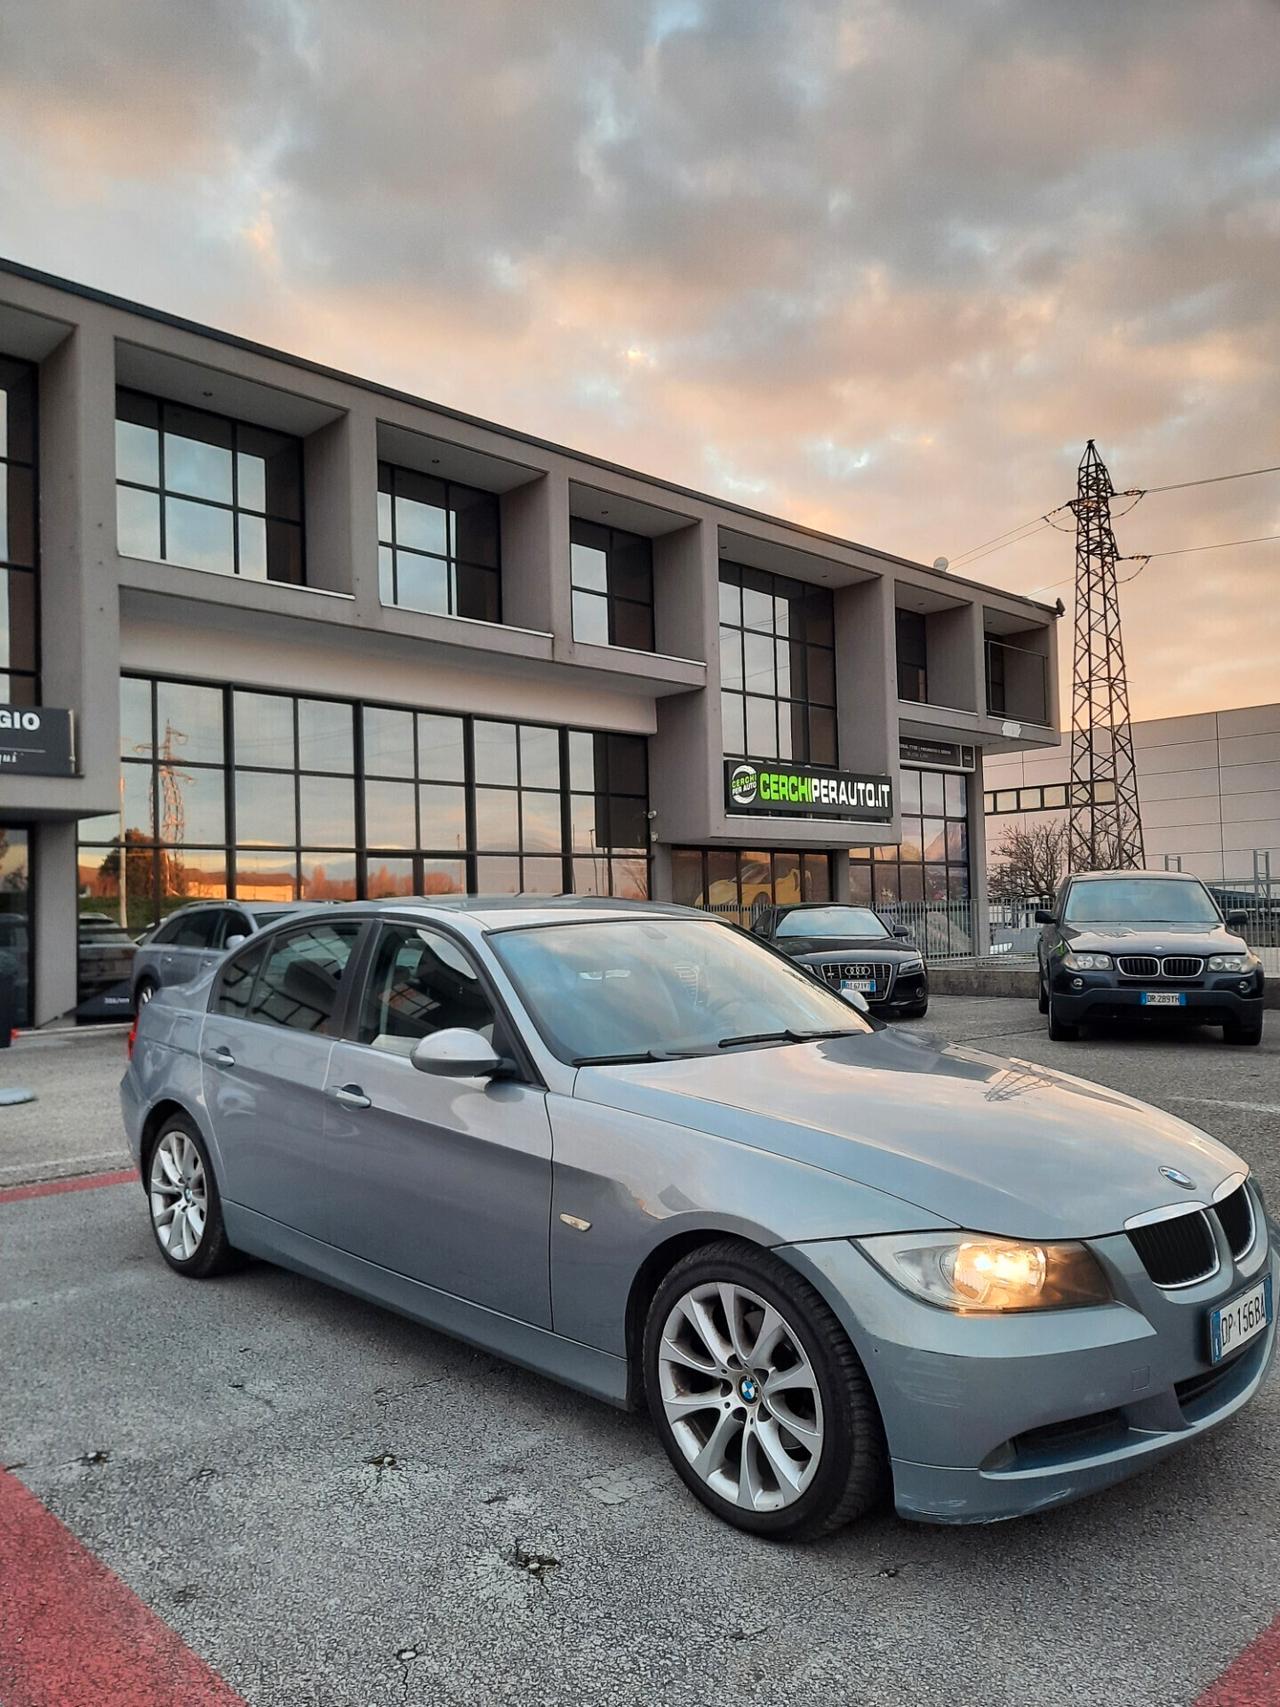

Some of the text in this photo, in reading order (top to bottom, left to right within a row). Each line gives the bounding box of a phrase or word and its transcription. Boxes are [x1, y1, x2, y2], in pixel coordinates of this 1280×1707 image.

[732, 773, 757, 788] CERCHI
[743, 781, 757, 792] AUTO
[759, 772, 891, 808] CERCHIPERAUTO.IT
